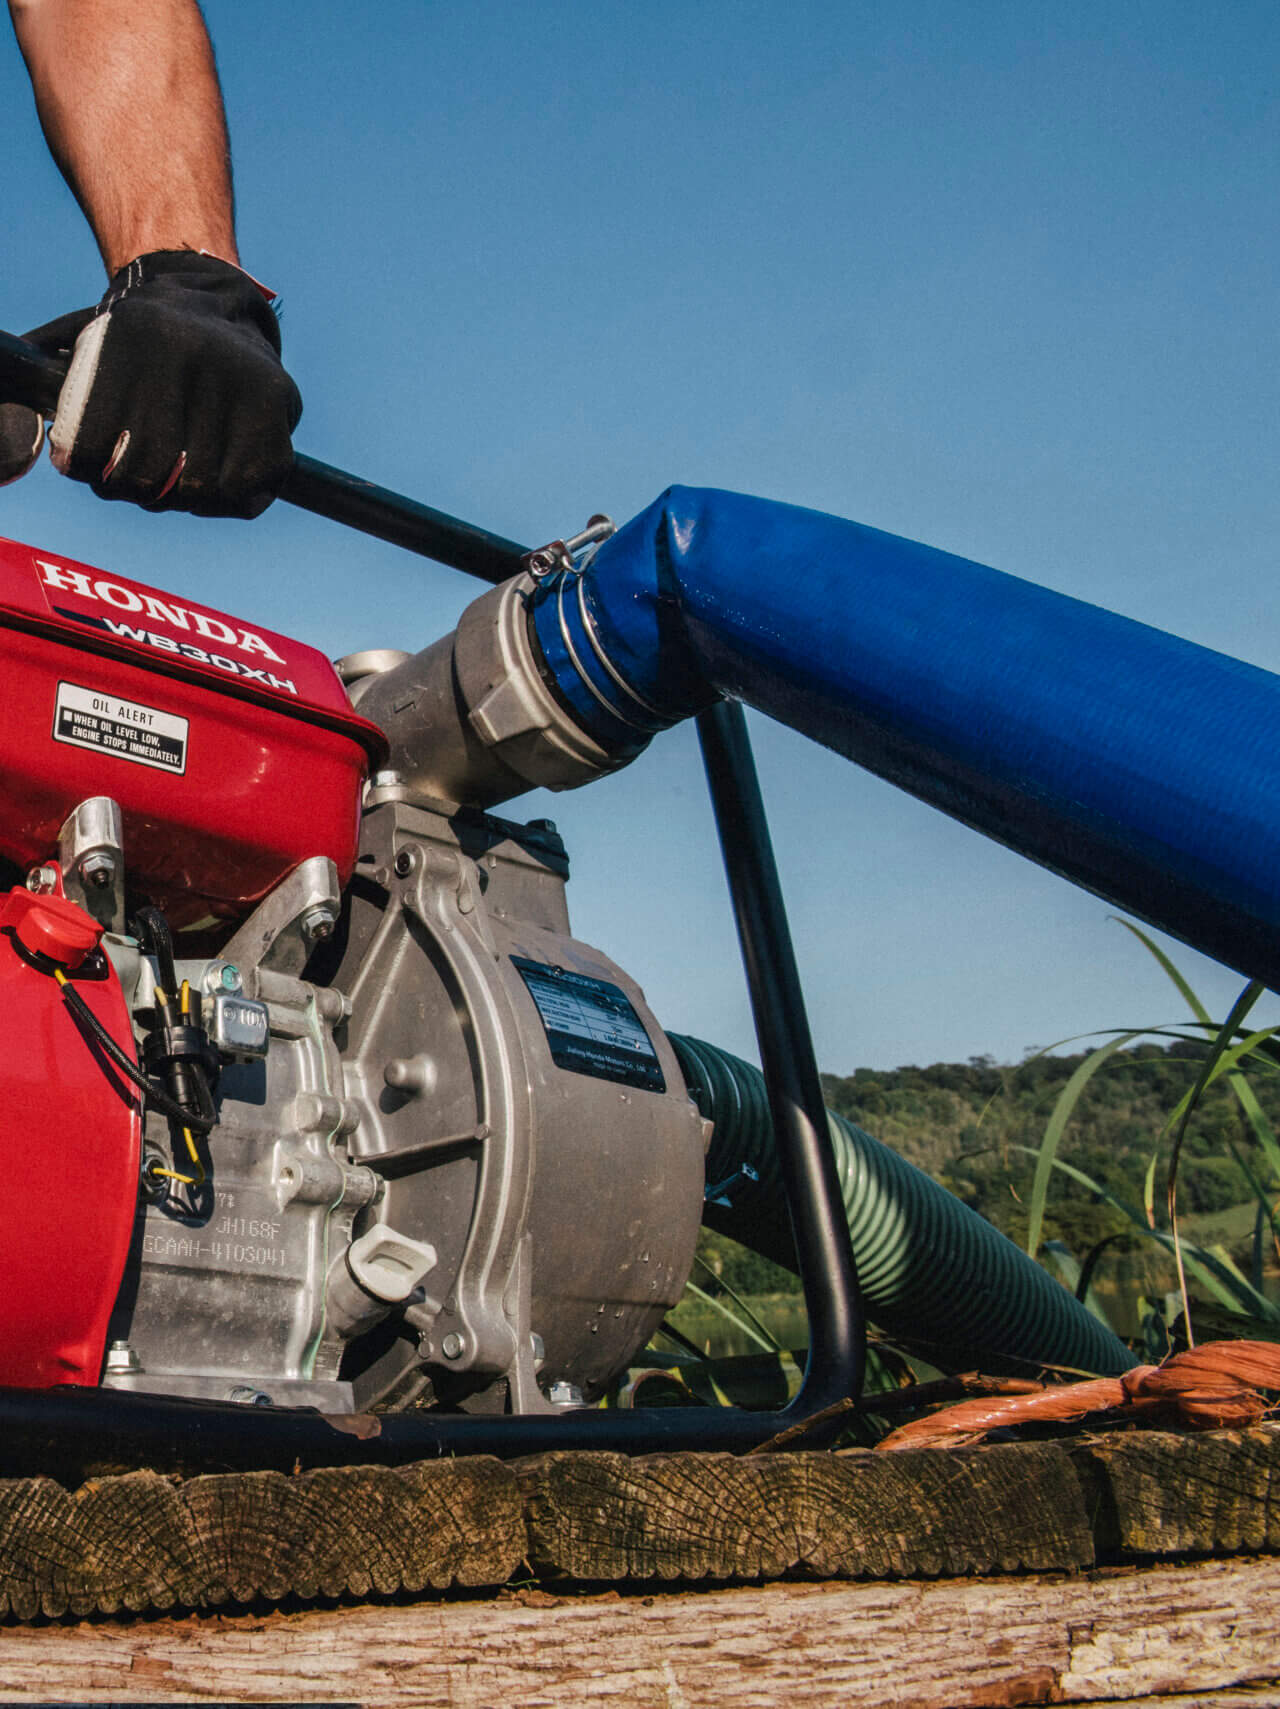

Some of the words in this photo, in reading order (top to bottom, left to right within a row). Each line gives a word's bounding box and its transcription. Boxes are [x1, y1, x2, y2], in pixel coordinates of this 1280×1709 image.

[36, 559, 287, 664] HONDA
[102, 616, 298, 695] WB30XH
[73, 712, 98, 729] WHEN
[100, 721, 113, 733] OIL
[116, 725, 138, 740] LEVEL
[142, 731, 160, 747] LOW,
[92, 698, 110, 713] OIL
[118, 706, 154, 726] ALERT
[72, 726, 100, 742] ENGINE
[103, 734, 127, 750] STOPS
[129, 741, 180, 765] IMMEDIATELY.
